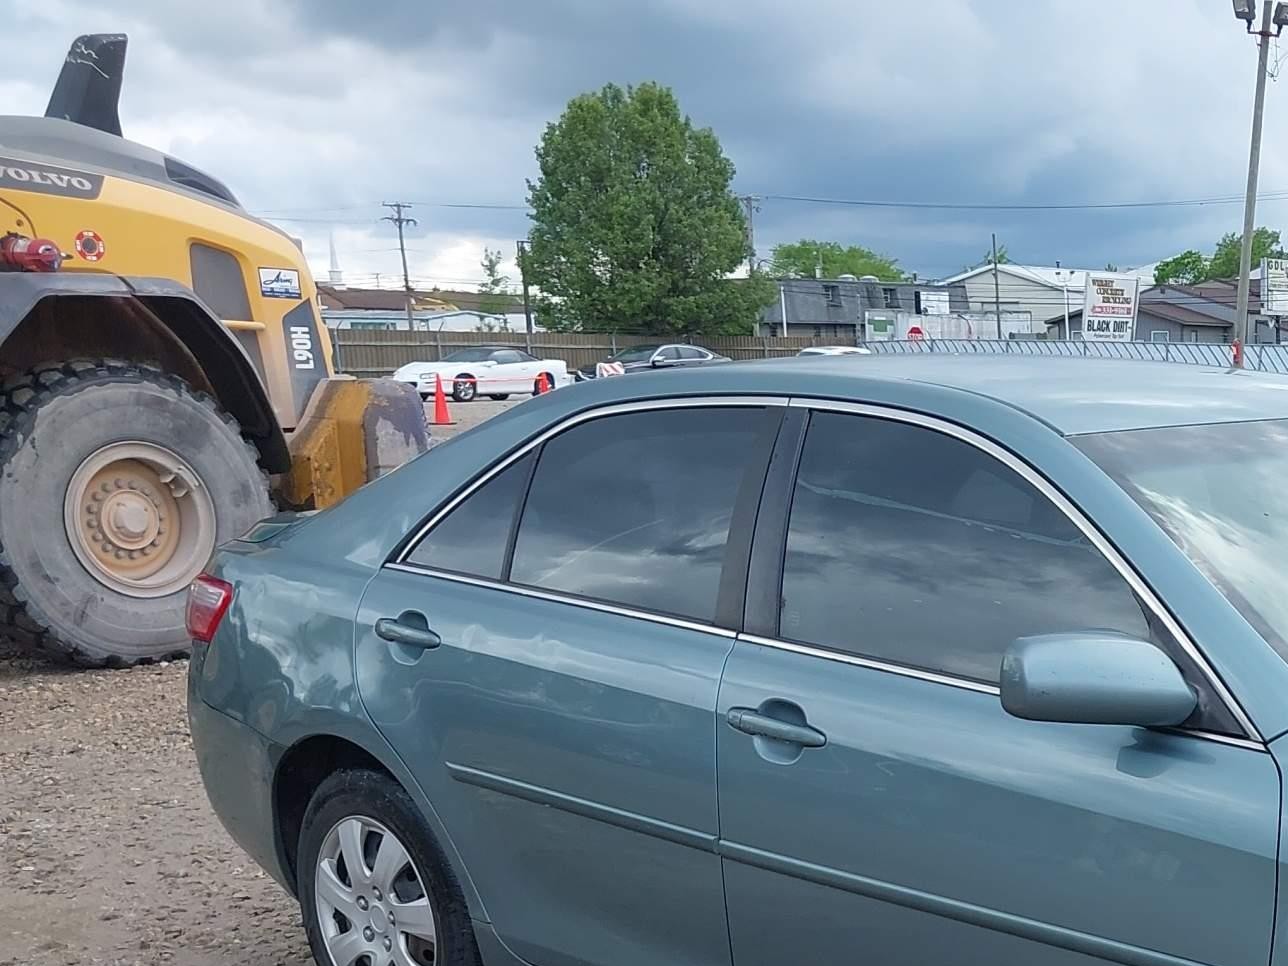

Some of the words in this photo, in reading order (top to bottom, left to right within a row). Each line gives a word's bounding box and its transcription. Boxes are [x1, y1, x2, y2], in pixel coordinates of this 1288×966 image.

[1268, 260, 1284, 271] GDL
[1087, 320, 1111, 332] BLACK
[290, 326, 315, 369] L90H
